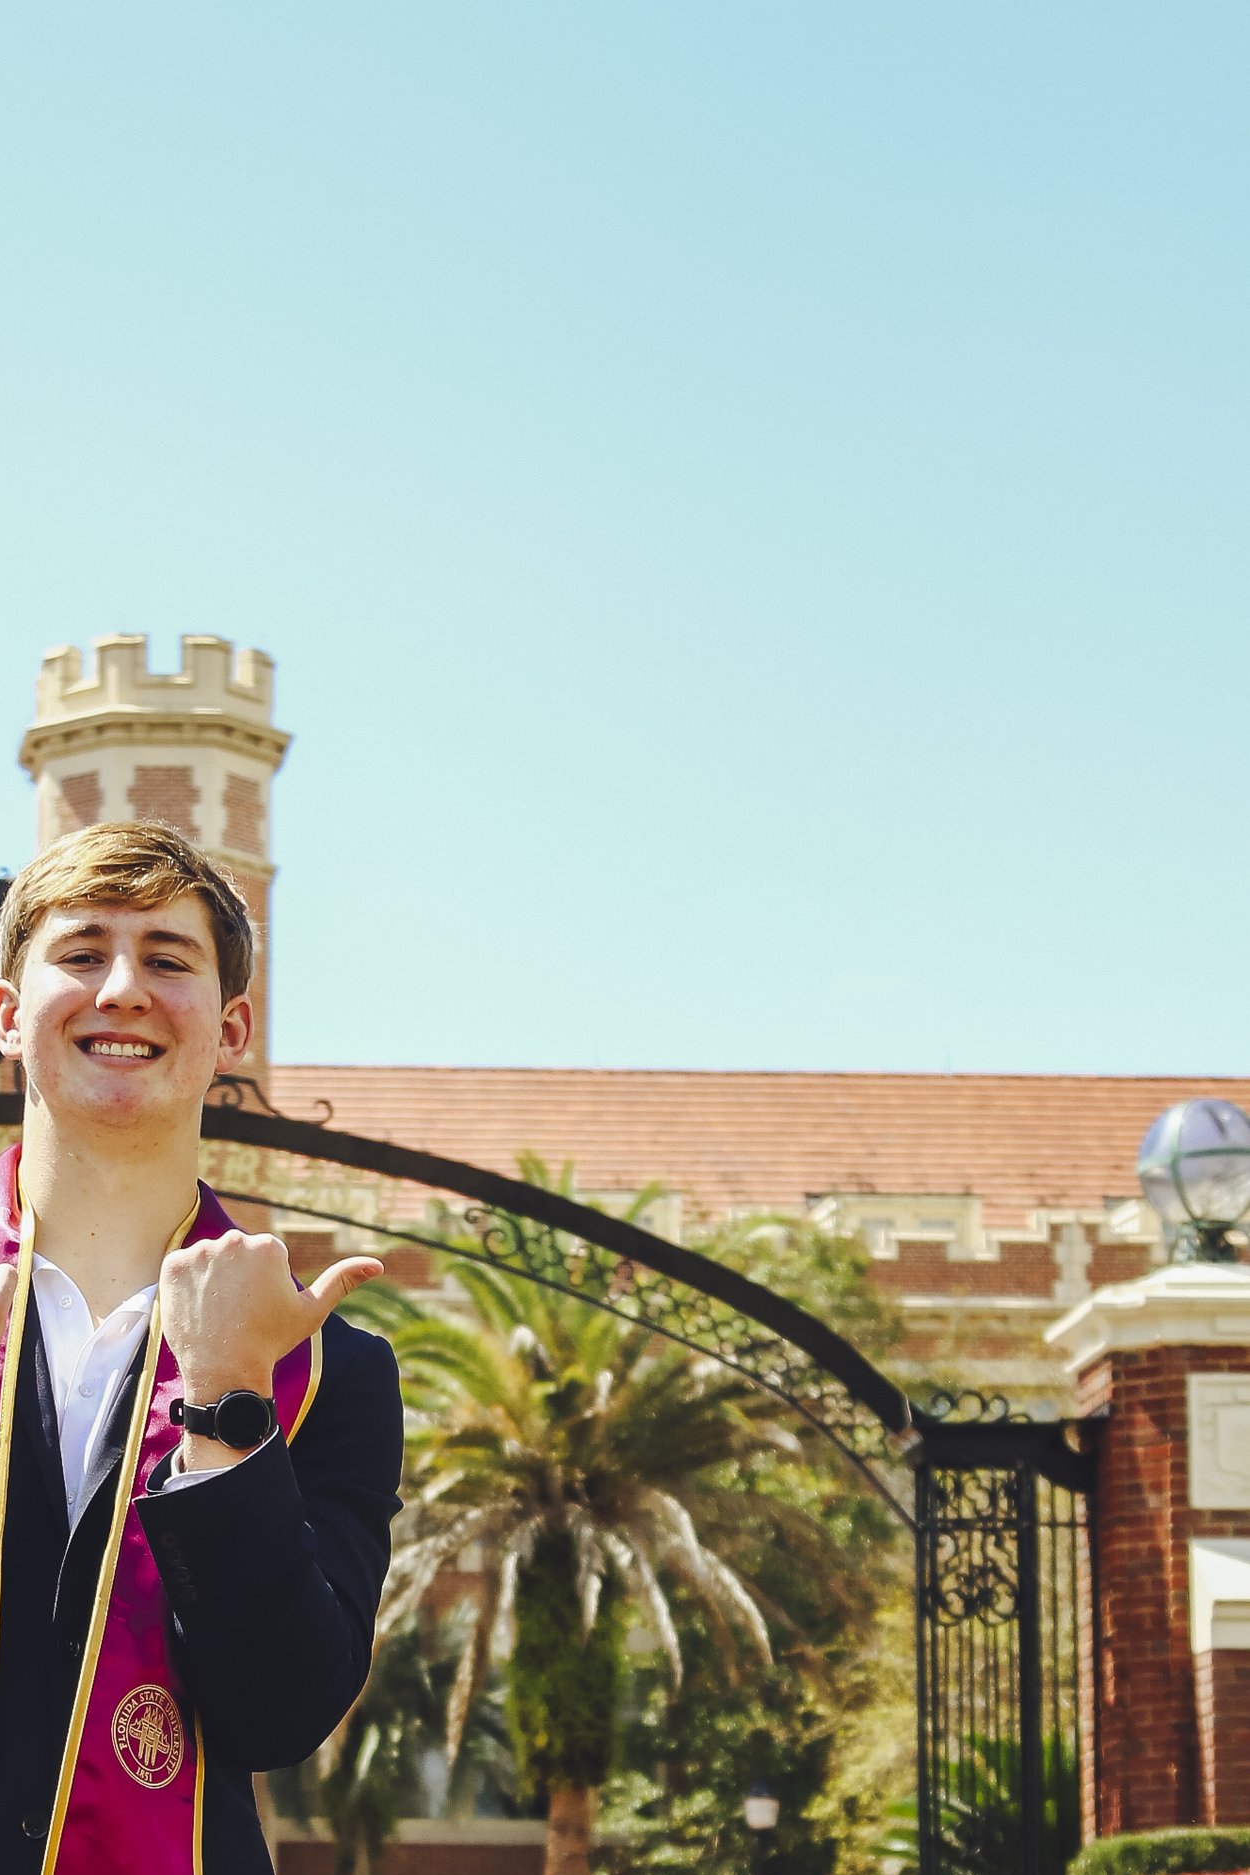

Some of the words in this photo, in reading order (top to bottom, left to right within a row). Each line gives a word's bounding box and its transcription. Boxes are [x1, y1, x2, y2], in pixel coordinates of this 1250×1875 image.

[117, 1698, 139, 1751] FLORIDA
[139, 1691, 165, 1705] STATE
[165, 1702, 180, 1775] UNIVERSITY
[136, 1766, 153, 1782] 1851
